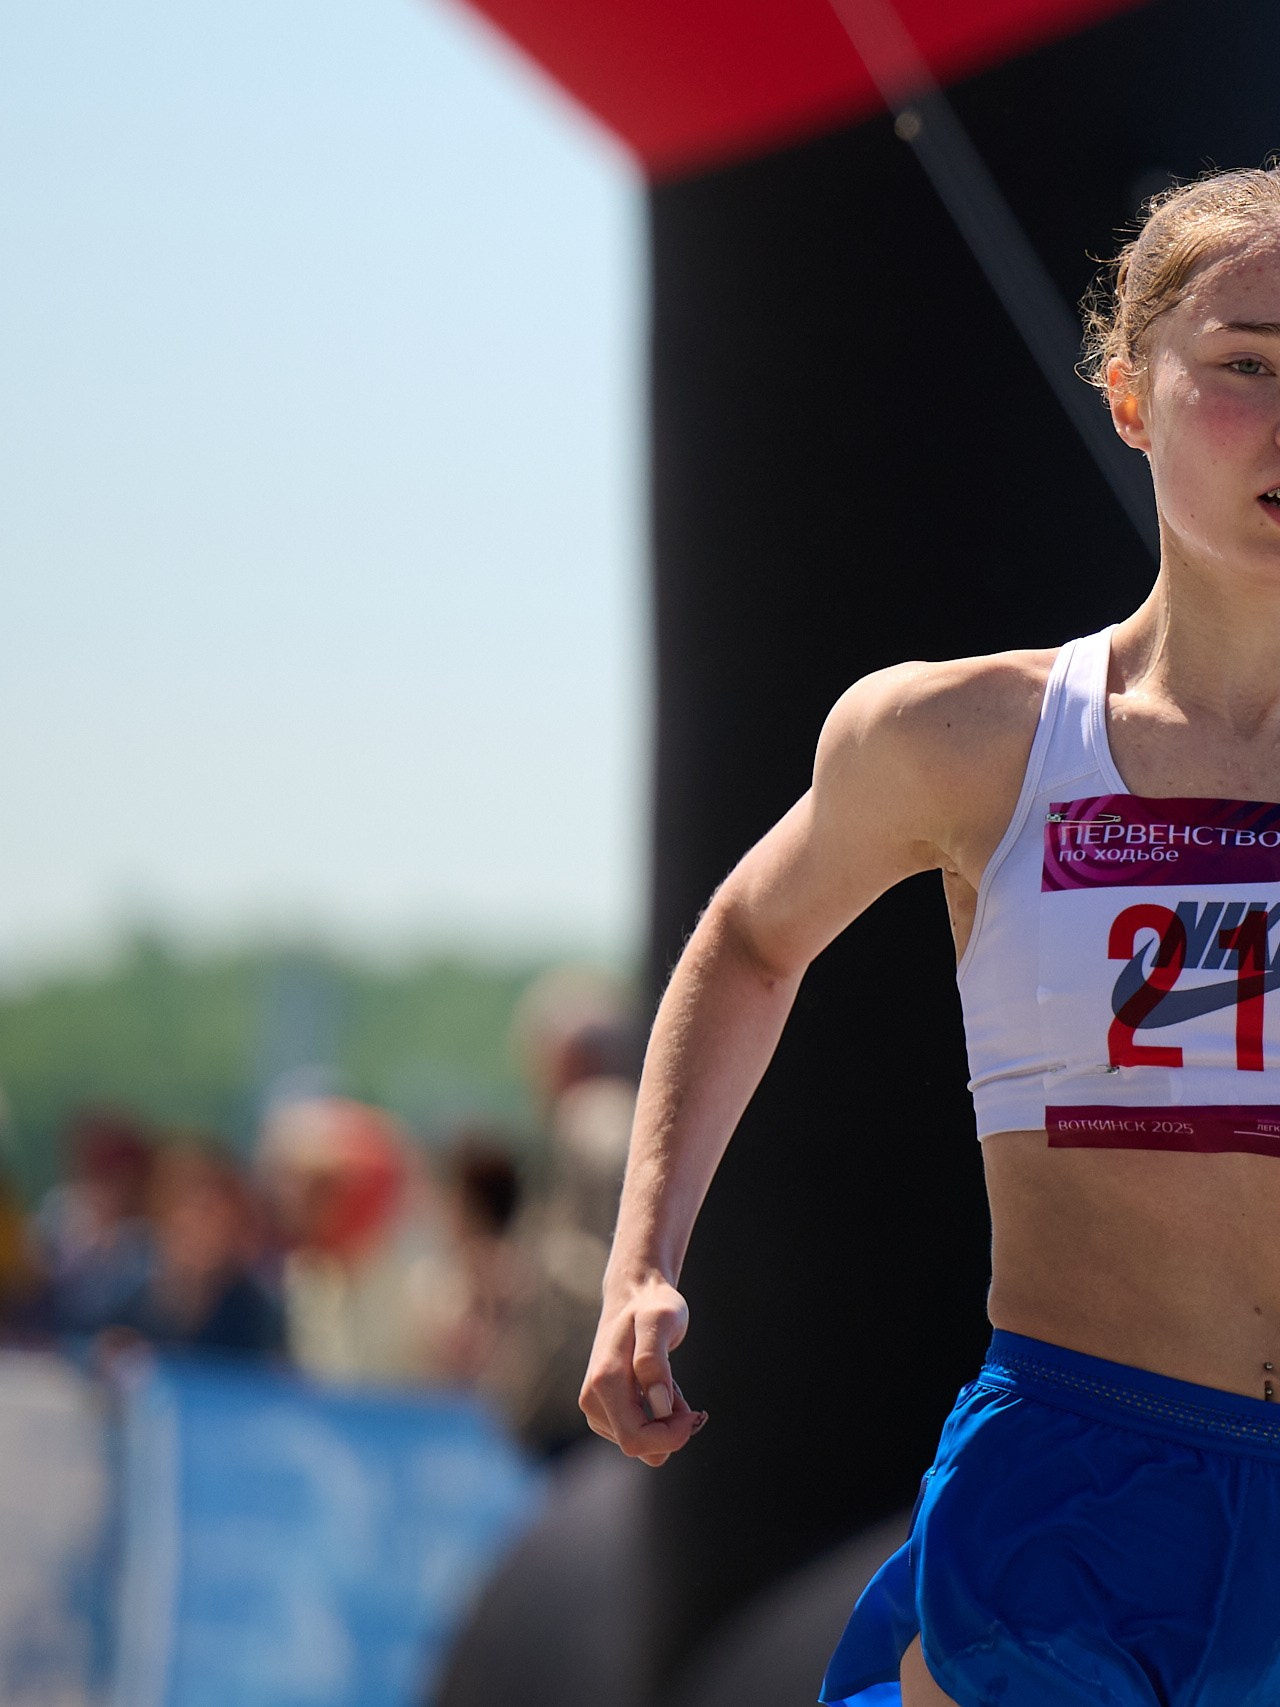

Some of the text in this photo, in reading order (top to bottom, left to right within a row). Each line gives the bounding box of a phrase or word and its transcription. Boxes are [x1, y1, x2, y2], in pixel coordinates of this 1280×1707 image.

[1058, 845, 1180, 863] по ходьбе
[1057, 1119, 1194, 1135] ВОТКИНСК 2025
